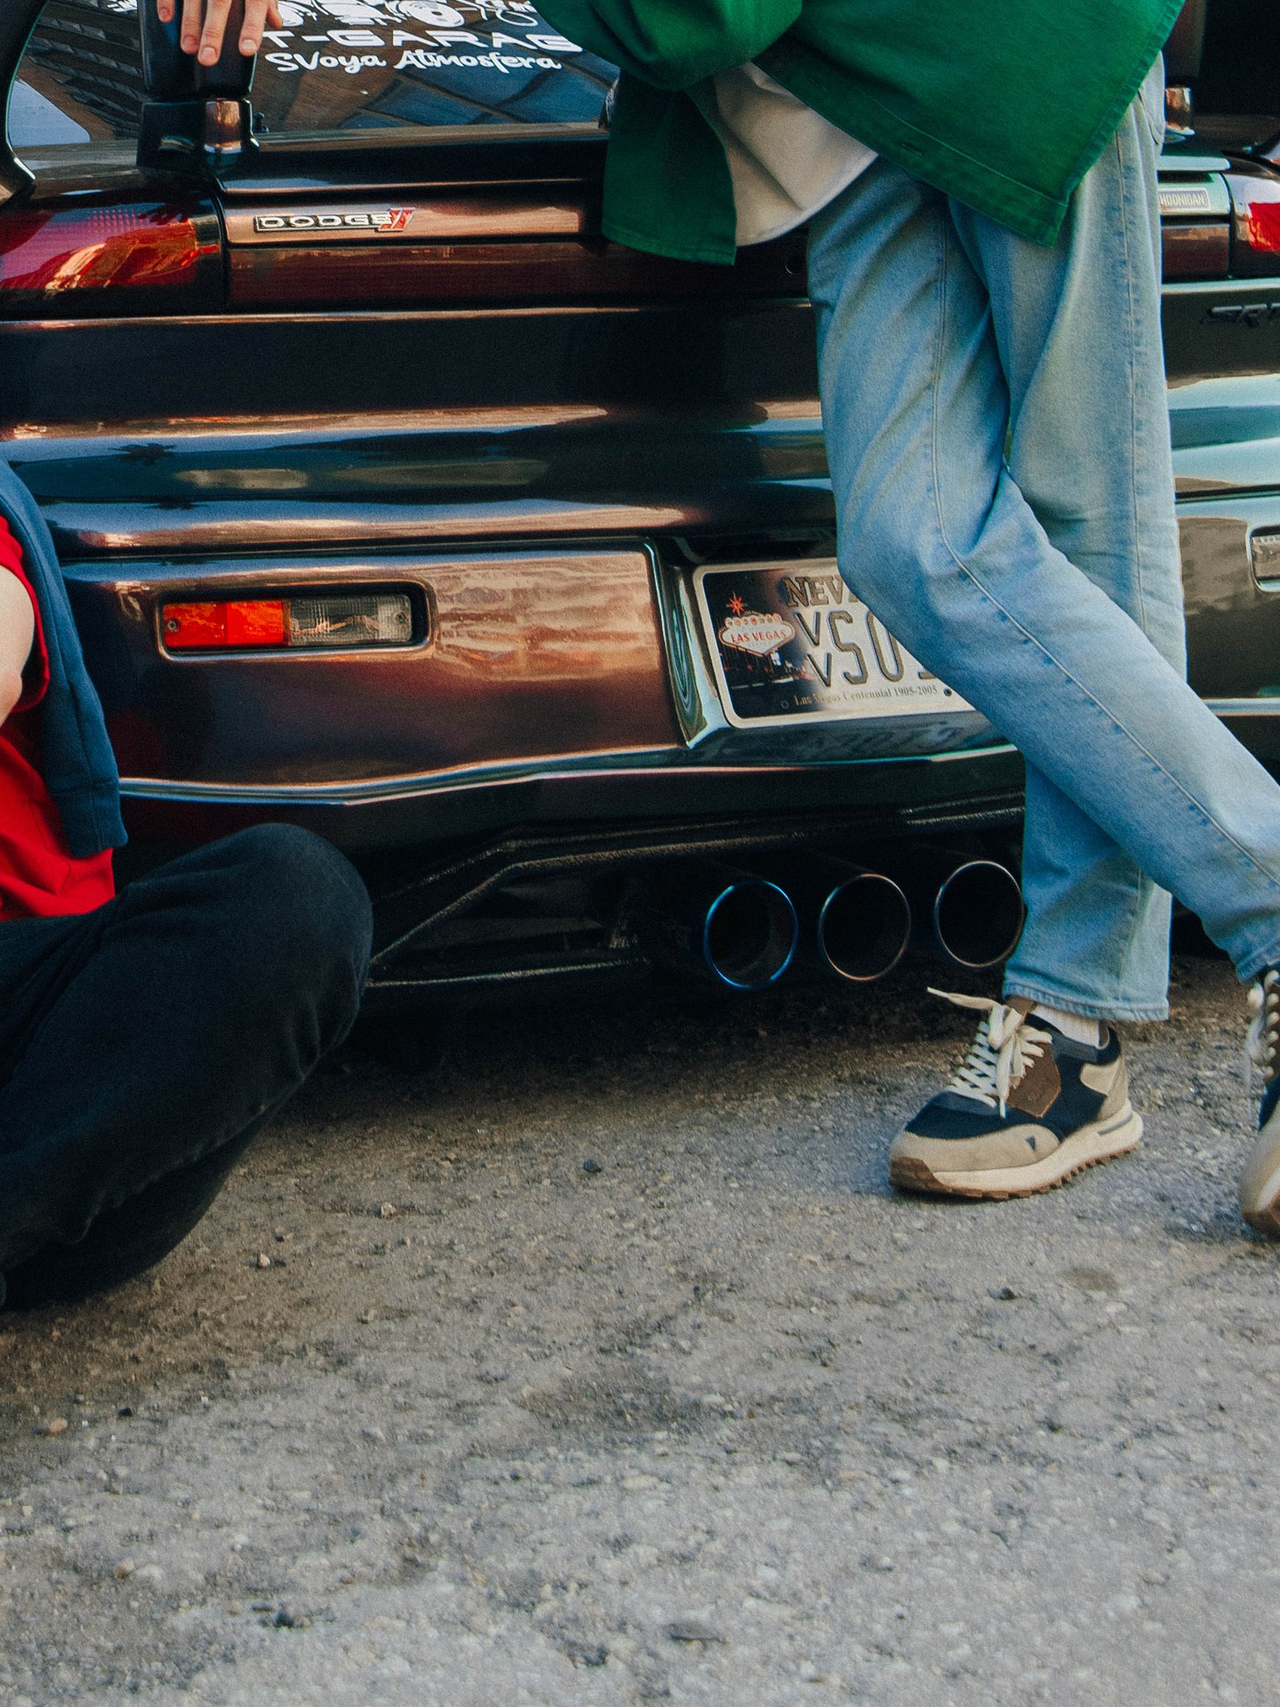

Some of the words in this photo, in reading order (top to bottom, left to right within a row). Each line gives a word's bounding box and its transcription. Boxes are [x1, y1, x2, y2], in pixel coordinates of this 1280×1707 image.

[264, 50, 387, 75] SVoya
[393, 48, 563, 74] Atmosfera
[1159, 193, 1205, 206] HOONIGAN
[260, 212, 393, 229] DODGE
[782, 575, 858, 606] NEV
[730, 632, 751, 644] LAS
[751, 629, 788, 643] VEGAS
[842, 687, 893, 702] Centennial
[893, 684, 939, 698] 1905-2005
